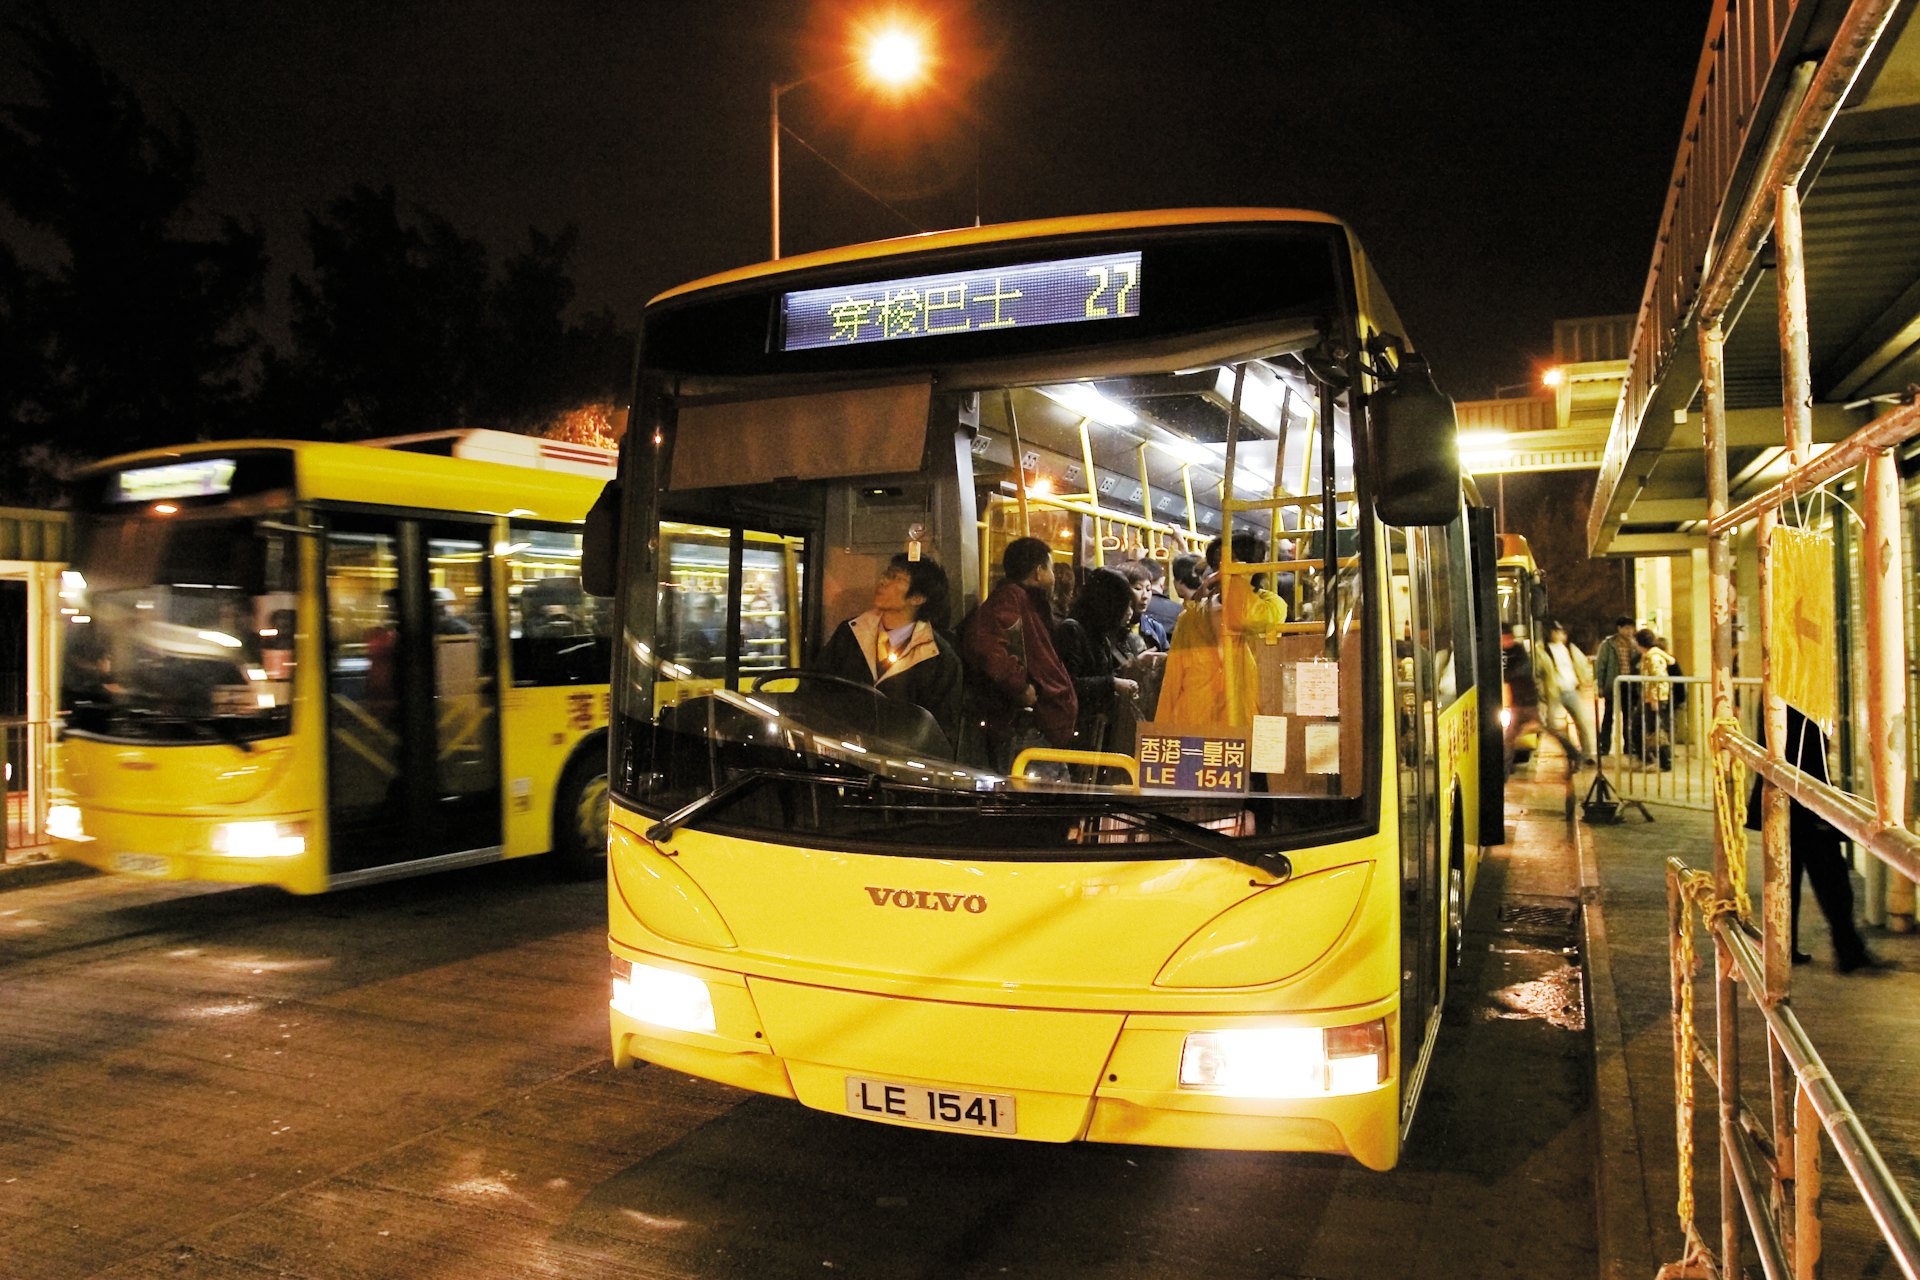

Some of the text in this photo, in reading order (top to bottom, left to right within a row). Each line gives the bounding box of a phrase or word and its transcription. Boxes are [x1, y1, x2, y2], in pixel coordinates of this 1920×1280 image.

[827, 262, 1138, 341] 穿梭巴士 27
[1140, 738, 1181, 764] 香港
[1202, 741, 1245, 768] 皇岗
[1146, 767, 1242, 789] LE 1541
[864, 886, 988, 914] VOLVO
[861, 1082, 998, 1127] LE 1541
